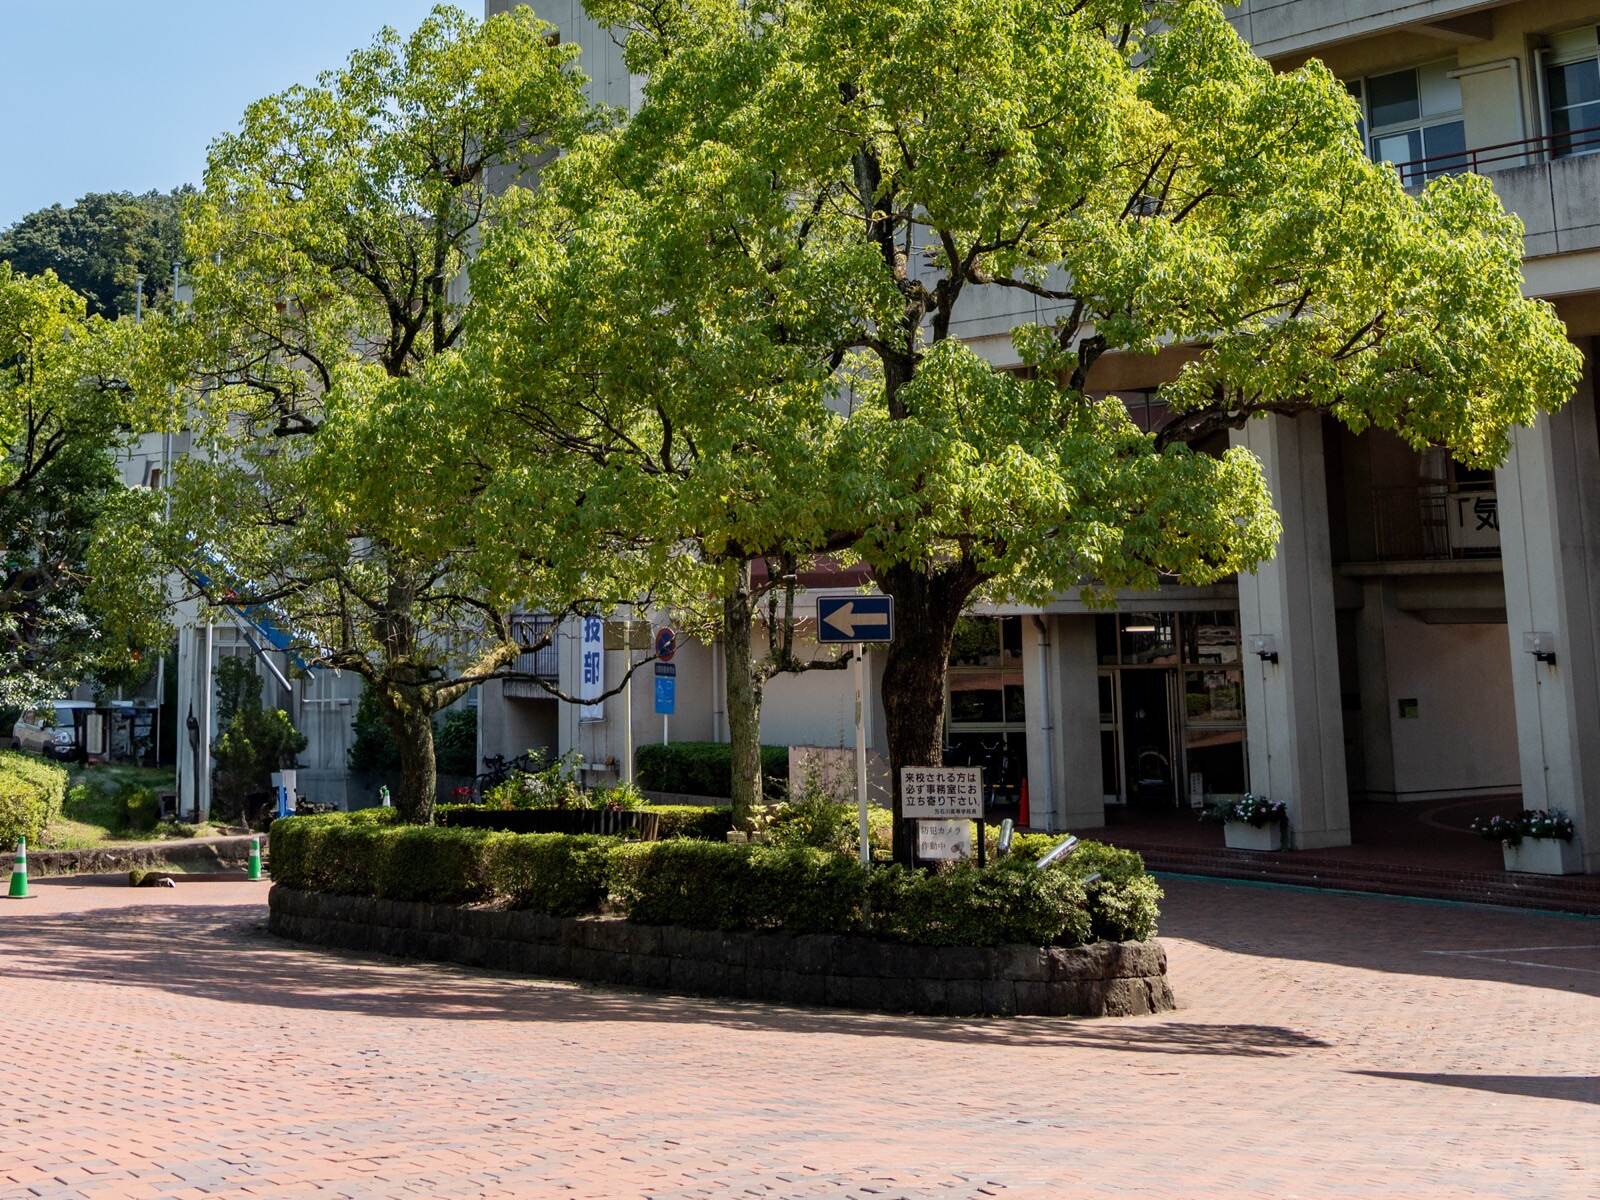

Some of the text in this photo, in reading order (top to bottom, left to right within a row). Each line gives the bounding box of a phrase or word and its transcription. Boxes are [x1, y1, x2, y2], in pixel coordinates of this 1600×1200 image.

[905, 773, 976, 783] 来校される方は
[906, 784, 977, 795] 必ず事務室にお
